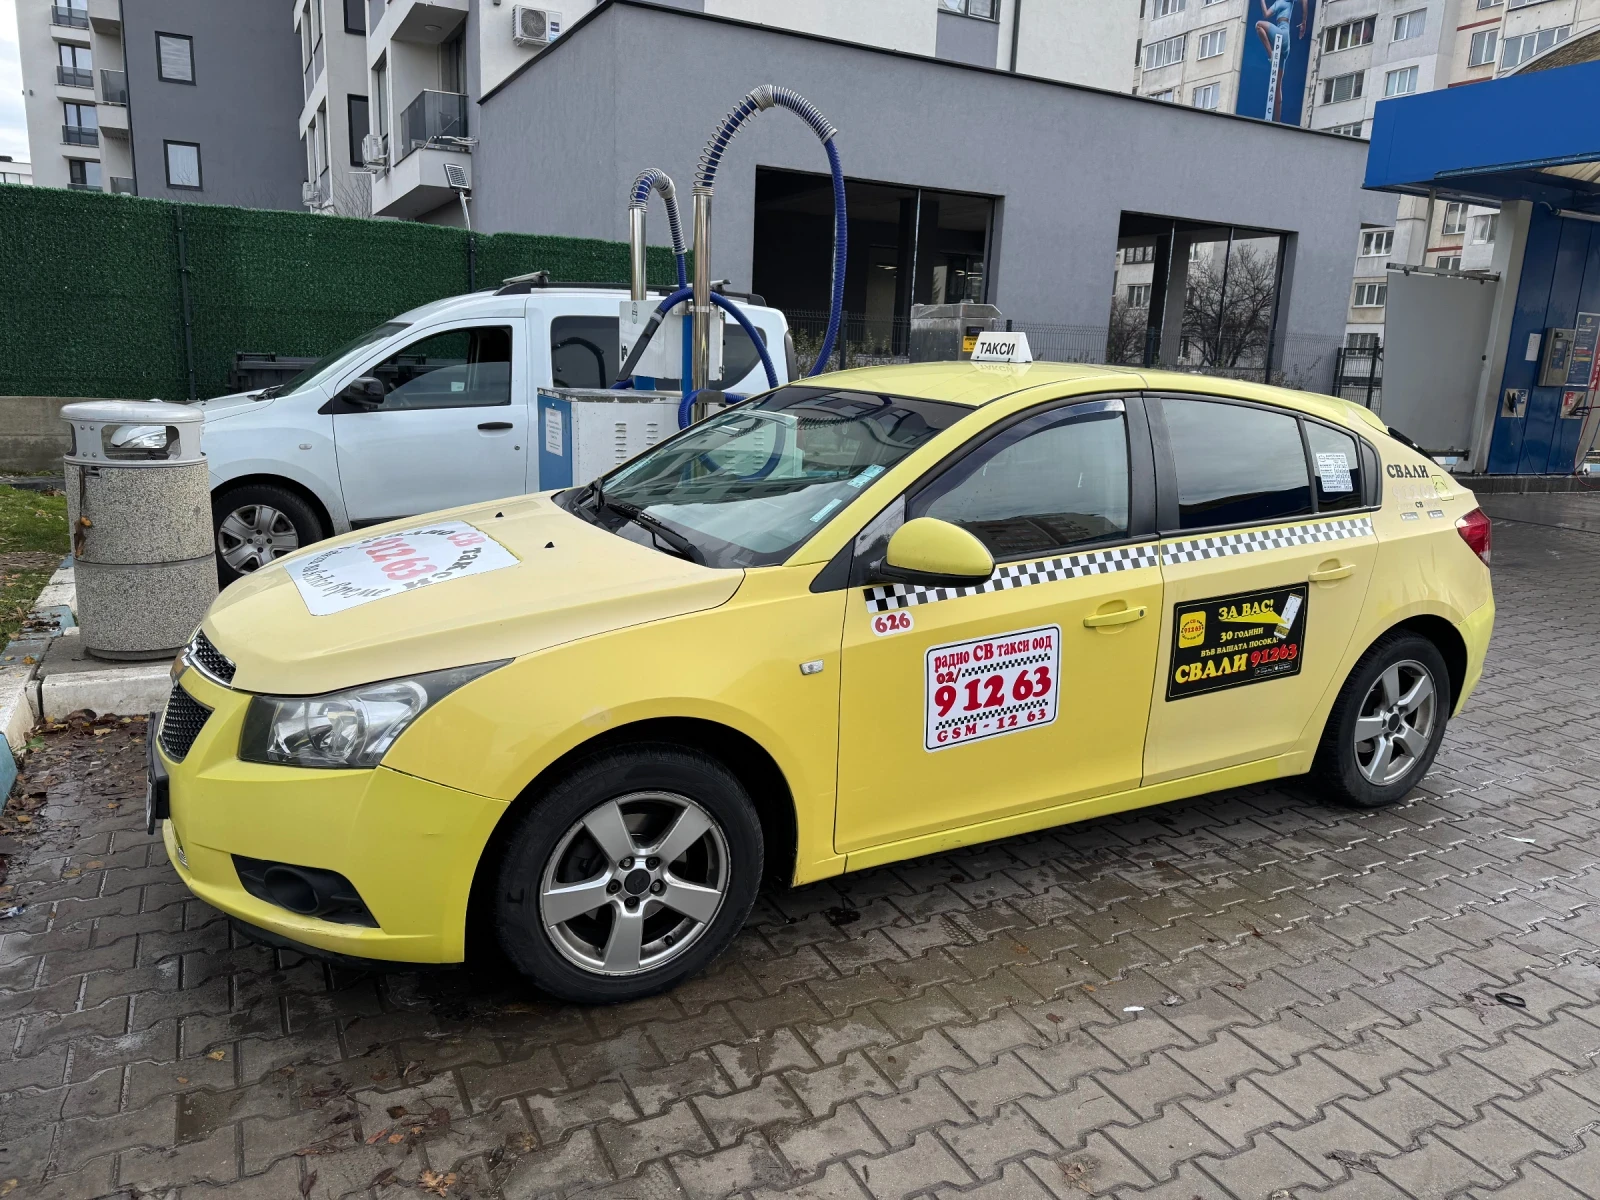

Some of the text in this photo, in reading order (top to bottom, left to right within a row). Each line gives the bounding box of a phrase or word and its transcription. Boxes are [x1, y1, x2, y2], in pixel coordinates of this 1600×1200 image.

[1269, 35, 1281, 103] ТРЕНИРАЙ
[980, 342, 1016, 355] ТАКСИ
[1386, 464, 1429, 478] СВАЛИ
[447, 532, 487, 547] СВ
[1218, 599, 1274, 620] ЗА ВАС!
[875, 612, 911, 633] 626
[1220, 627, 1264, 642] 30 ГОДИНИ
[934, 635, 1053, 673] радио СВ такси оод
[1201, 636, 1279, 657] ВЪВ ВАШАТА ПОСОКА!
[1175, 643, 1298, 684] СВАЛИ 91263
[936, 667, 962, 685] 02/
[937, 722, 977, 743] GSM
